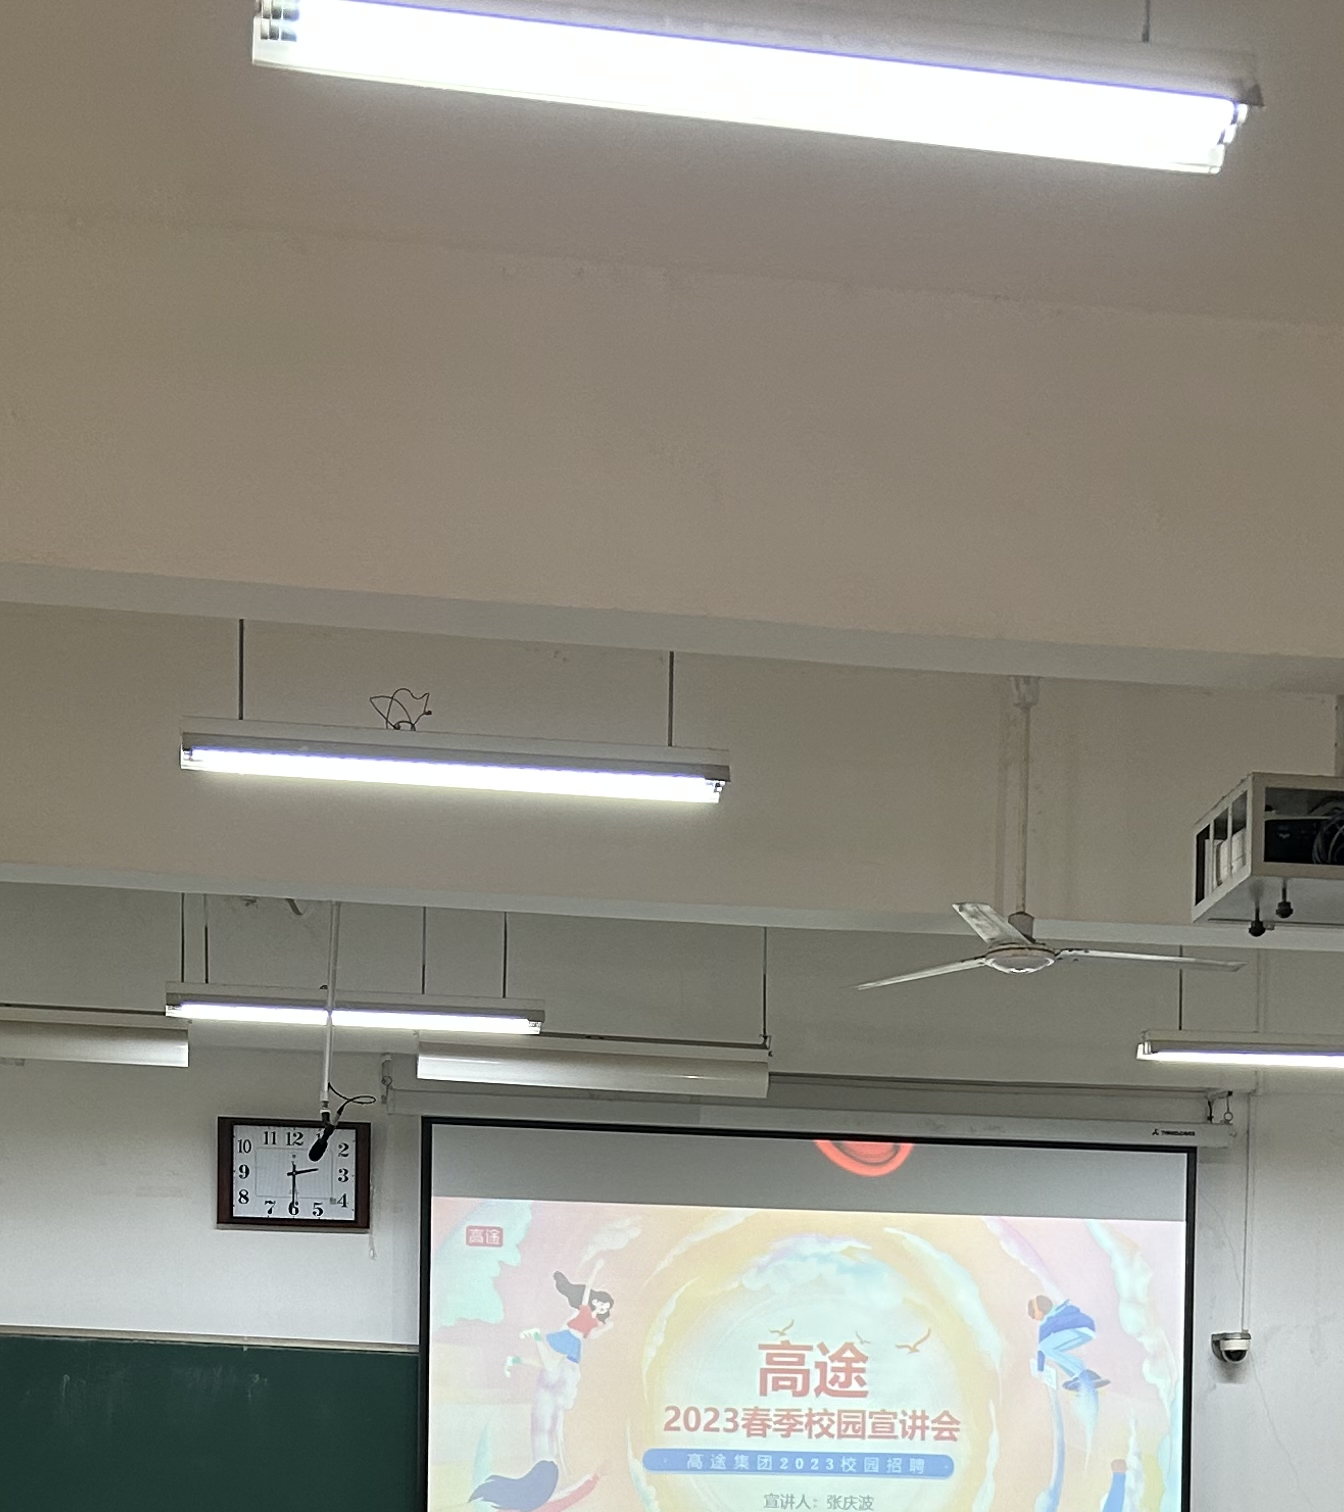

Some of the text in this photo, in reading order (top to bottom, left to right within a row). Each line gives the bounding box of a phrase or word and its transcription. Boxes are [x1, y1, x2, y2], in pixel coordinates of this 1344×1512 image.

[237, 1138, 252, 1154] 10
[263, 1131, 277, 1145] 11
[286, 1131, 304, 1146] 12
[337, 1142, 350, 1158] 2
[238, 1164, 250, 1180] 9
[337, 1168, 349, 1183] 3
[238, 1189, 250, 1205] 8
[336, 1193, 349, 1208] 4
[264, 1200, 277, 1215] 7
[288, 1200, 300, 1216] 6
[312, 1202, 324, 1217] 5
[469, 1228, 501, 1245] 高途
[757, 1339, 870, 1399] 高途
[663, 1404, 962, 1443] 2023春季校园宣讲会
[685, 1453, 926, 1474] 高途集团2023校园招聘
